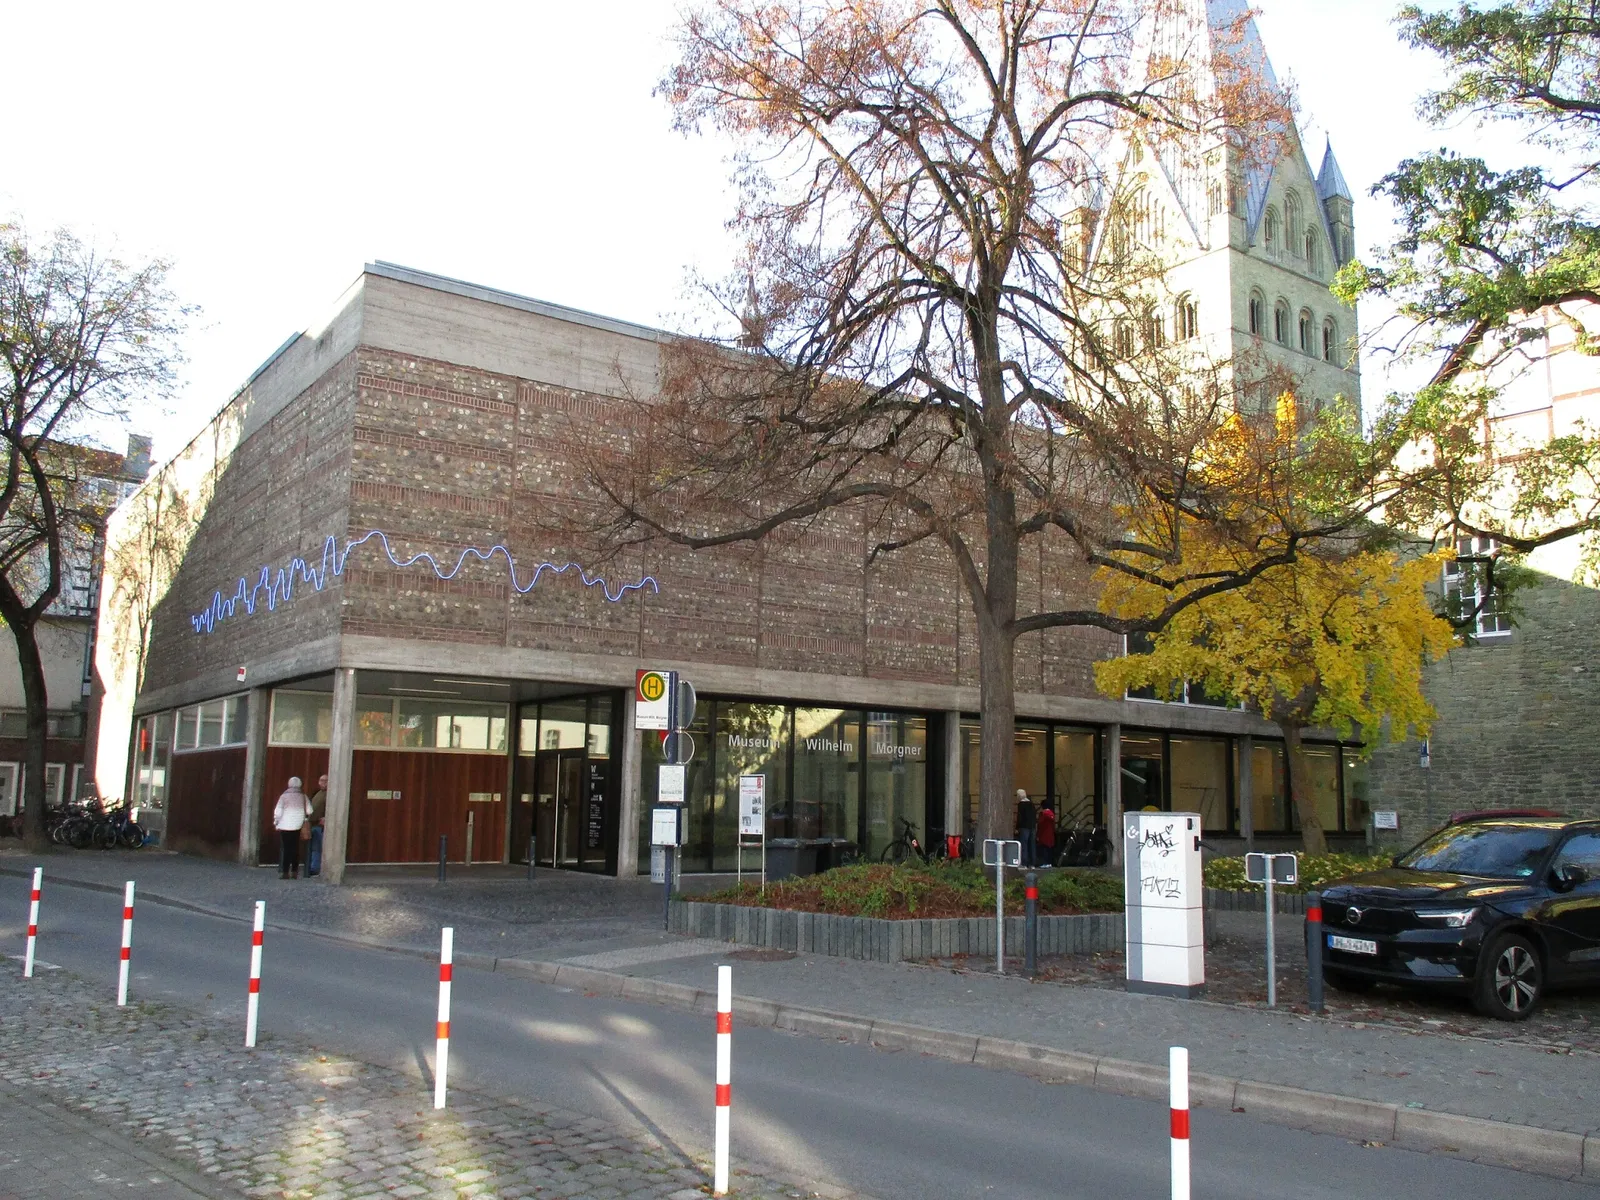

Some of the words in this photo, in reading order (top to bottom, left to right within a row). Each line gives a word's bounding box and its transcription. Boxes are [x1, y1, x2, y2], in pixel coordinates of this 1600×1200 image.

[648, 679, 658, 695] H
[728, 734, 780, 749] Museum
[806, 738, 853, 752] Wilhelm
[876, 742, 922, 757] Morgner
